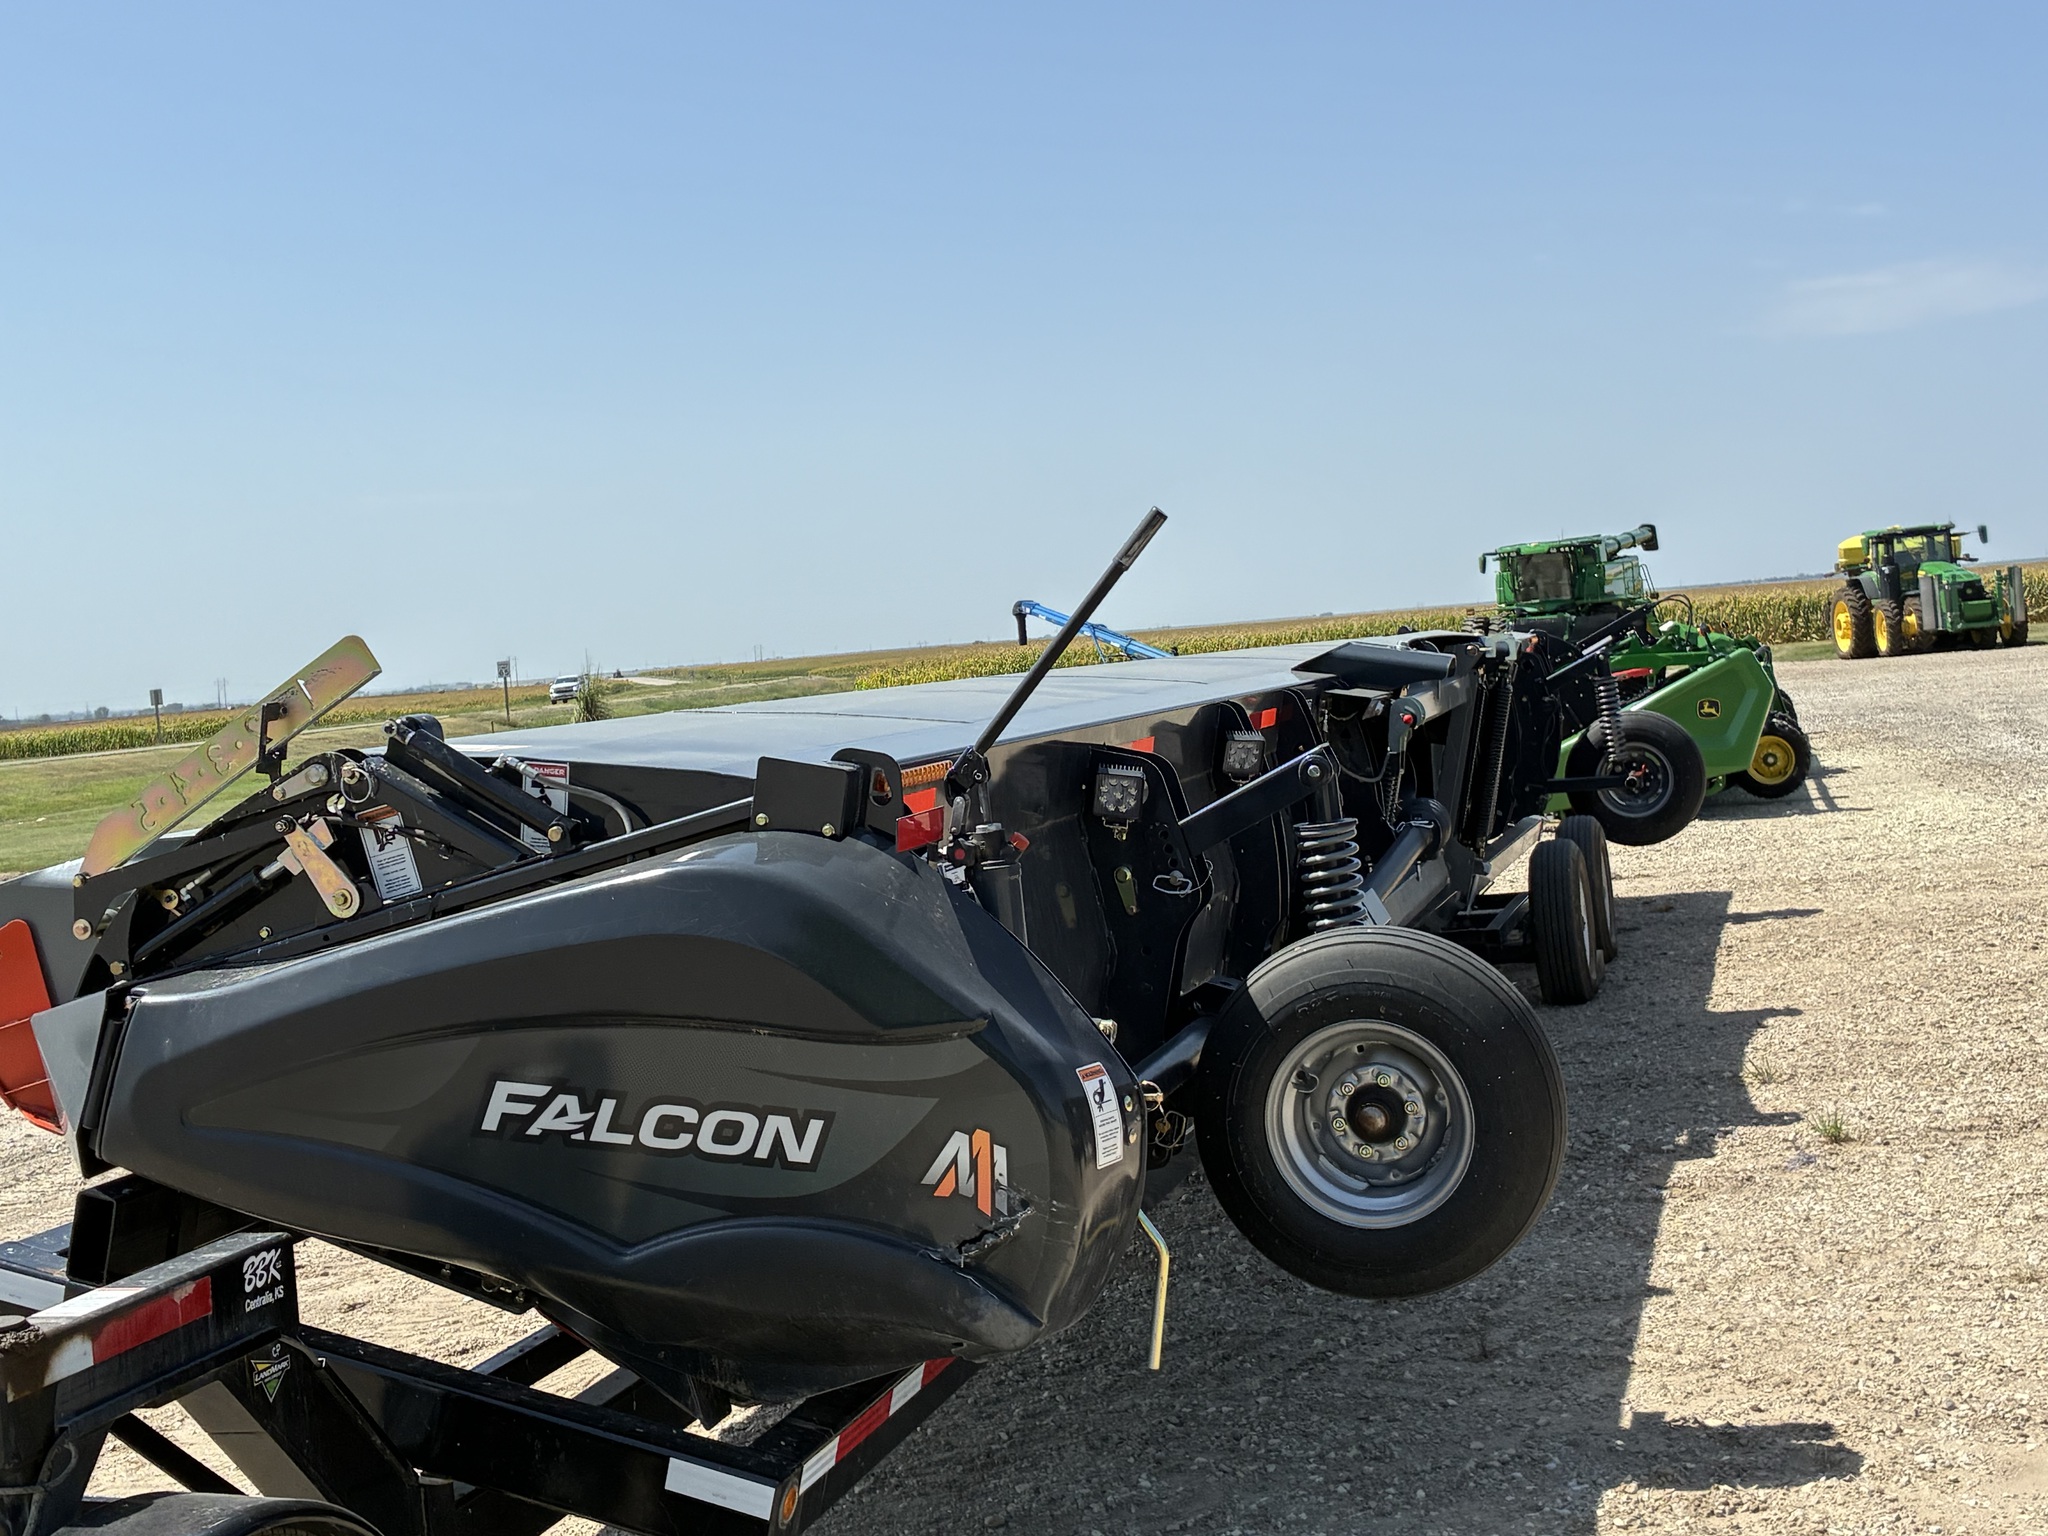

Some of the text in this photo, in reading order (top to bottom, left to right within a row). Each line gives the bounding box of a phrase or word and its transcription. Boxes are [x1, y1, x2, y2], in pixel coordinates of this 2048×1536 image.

[481, 1080, 825, 1164] FALCON
[243, 1248, 281, 1293] BBK
[245, 1285, 284, 1313] Centralia, KS
